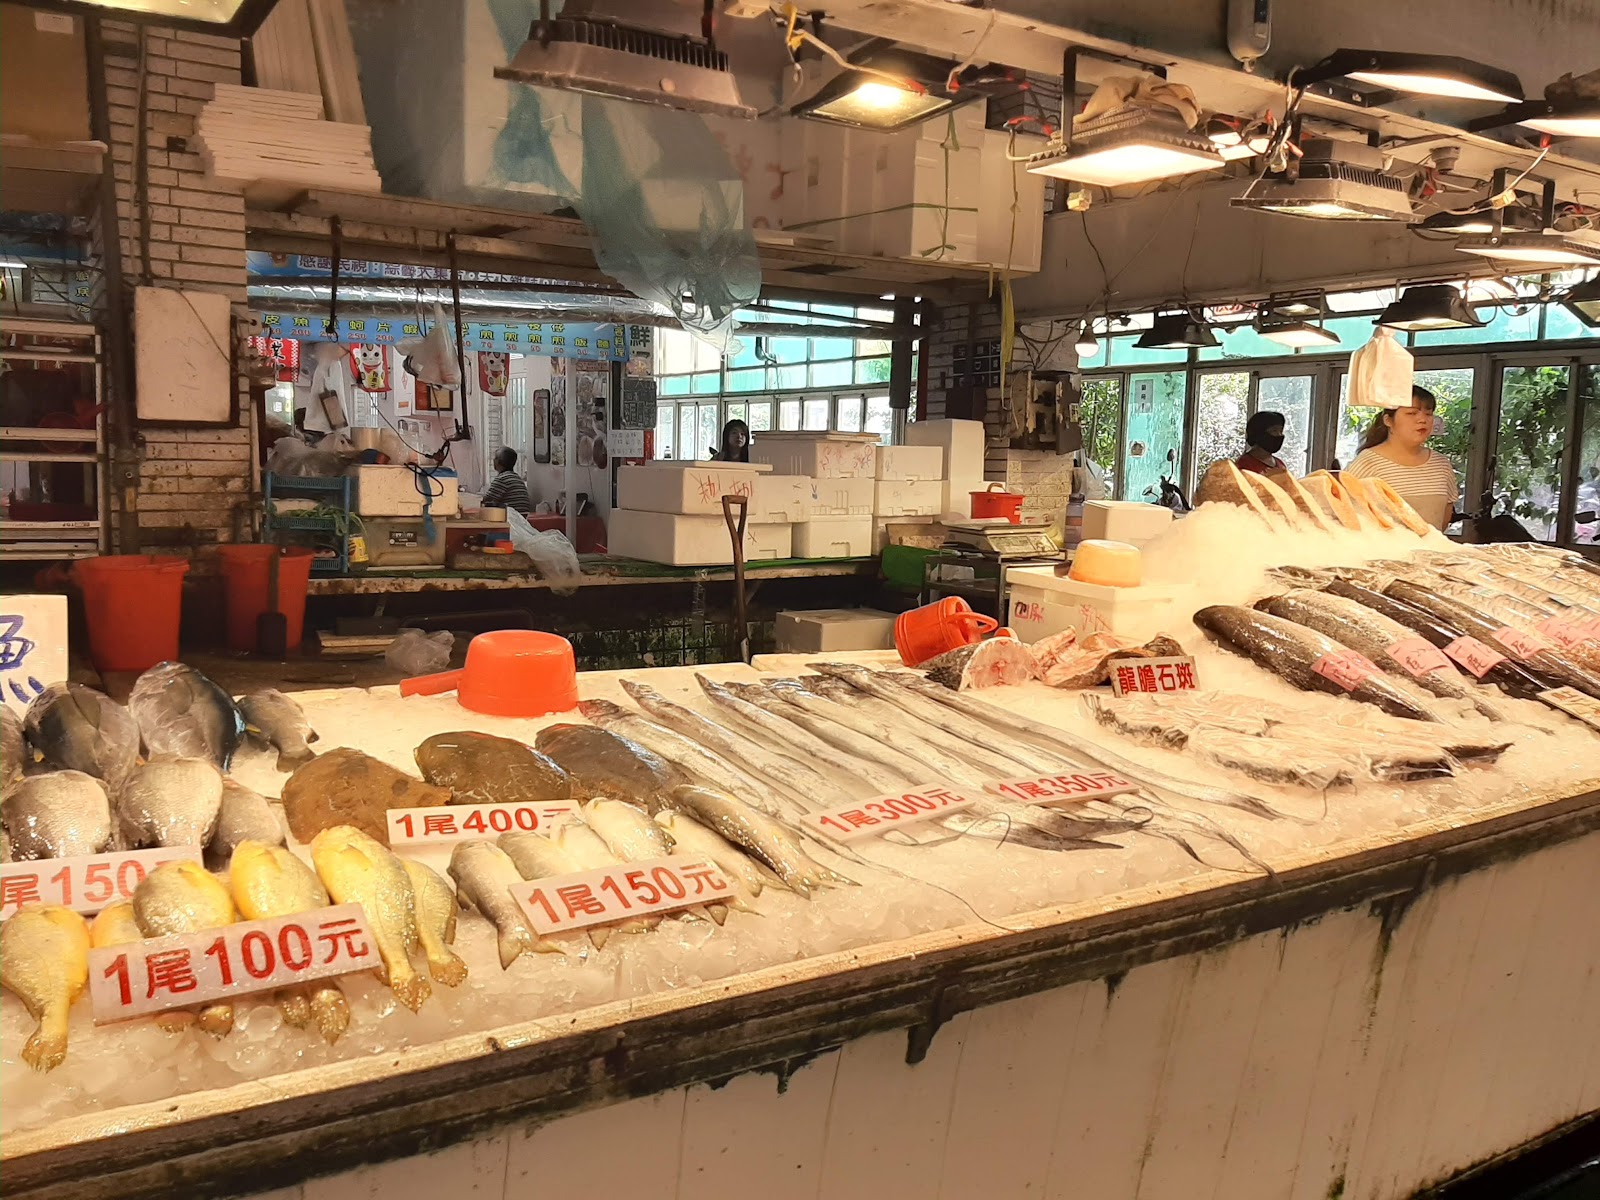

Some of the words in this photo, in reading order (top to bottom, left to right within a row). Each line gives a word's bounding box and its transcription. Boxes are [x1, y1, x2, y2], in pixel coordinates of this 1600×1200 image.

[819, 788, 966, 833] 1尾300元
[999, 772, 1129, 800] 1尾350元
[0, 860, 172, 909] 尾150
[528, 863, 727, 924] 1尾150元
[104, 918, 369, 1006] 1尾100元
